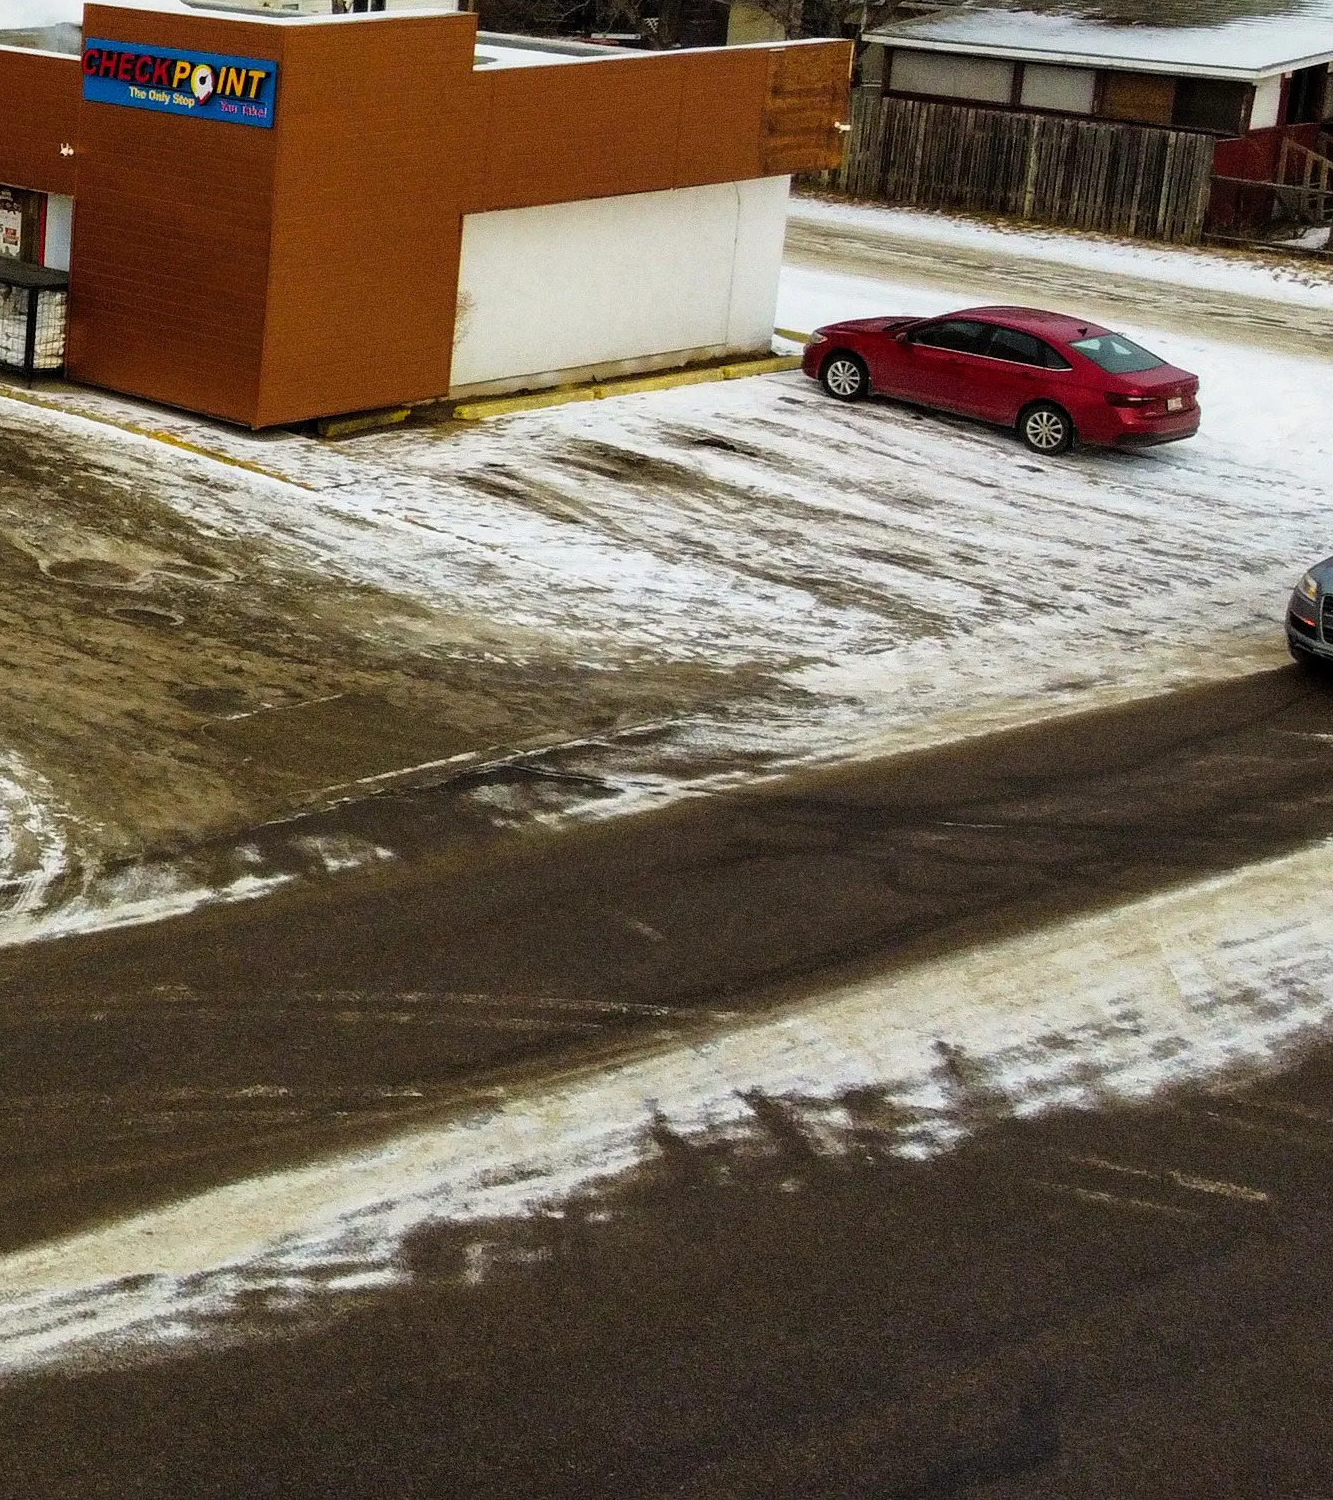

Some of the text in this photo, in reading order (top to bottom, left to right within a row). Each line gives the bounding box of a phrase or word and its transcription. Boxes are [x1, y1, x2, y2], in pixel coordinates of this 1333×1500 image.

[83, 48, 266, 105] CHECKPOINT
[129, 86, 196, 108] The Only Stop
